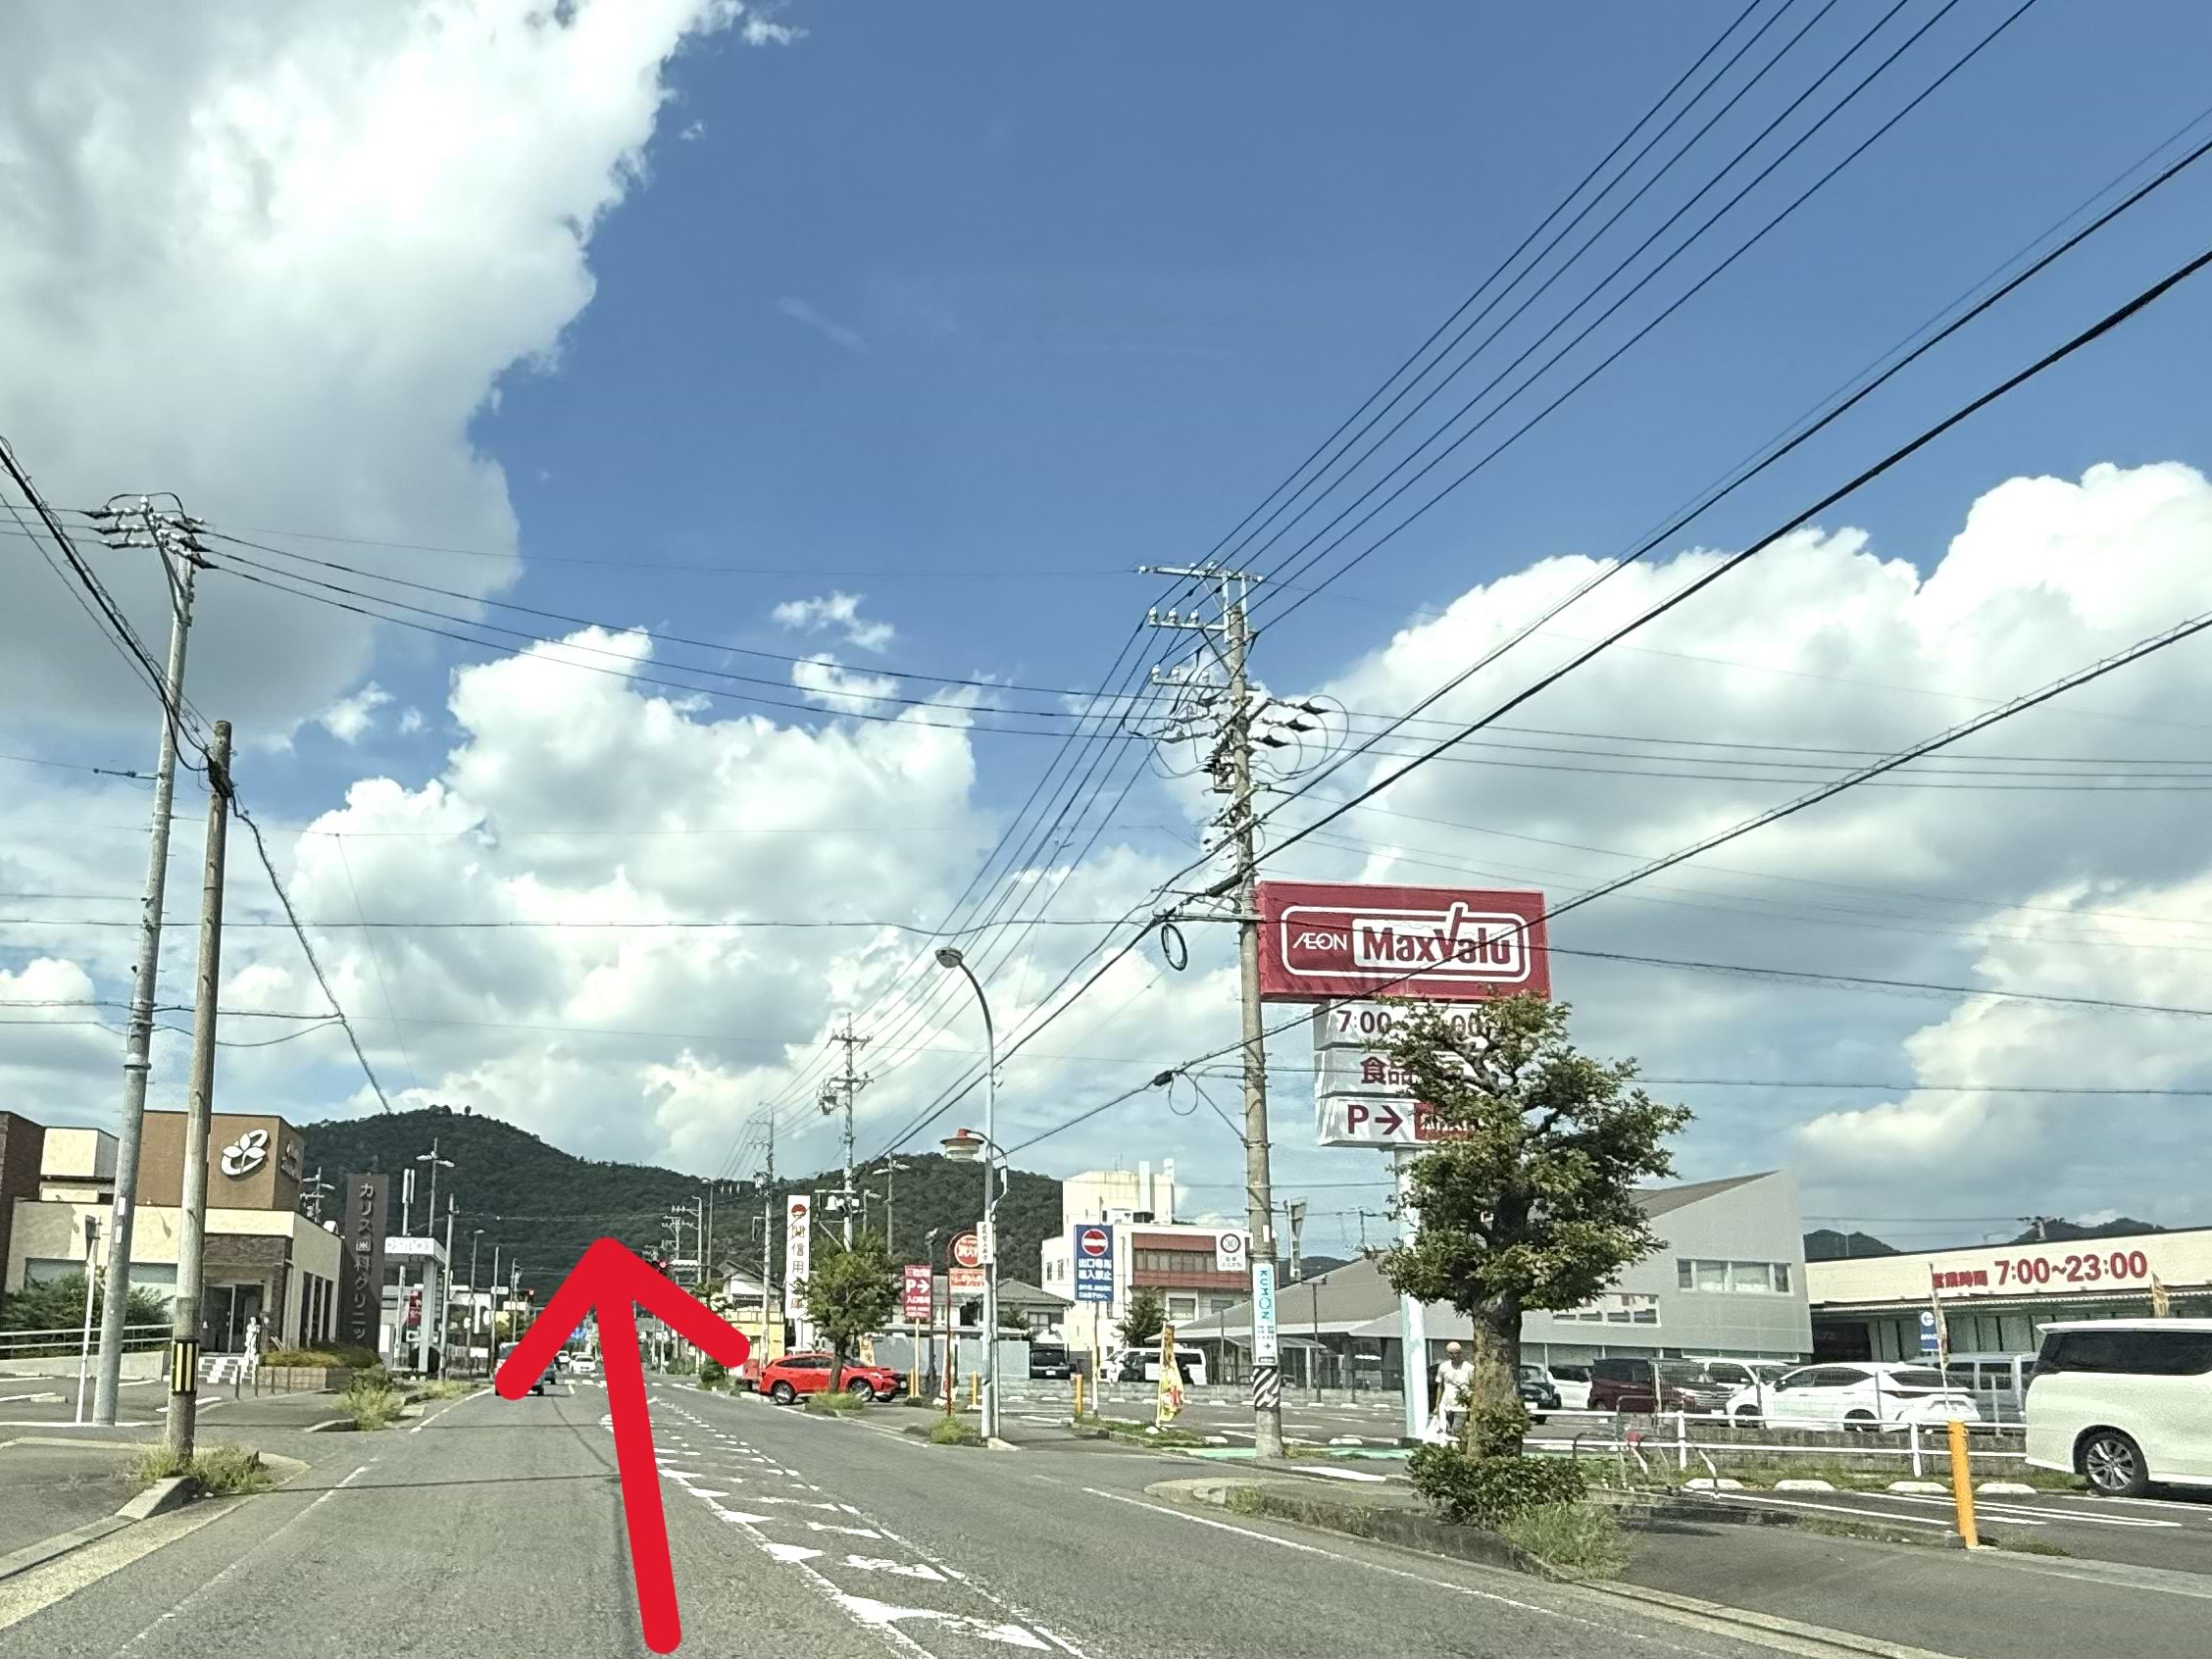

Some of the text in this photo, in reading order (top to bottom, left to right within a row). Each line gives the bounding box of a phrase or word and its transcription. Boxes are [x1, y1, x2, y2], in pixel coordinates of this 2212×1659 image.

[1362, 906, 1512, 965] MaxValu
[1347, 1103, 1370, 1135] P
[1259, 1270, 1272, 1320] KUMON
